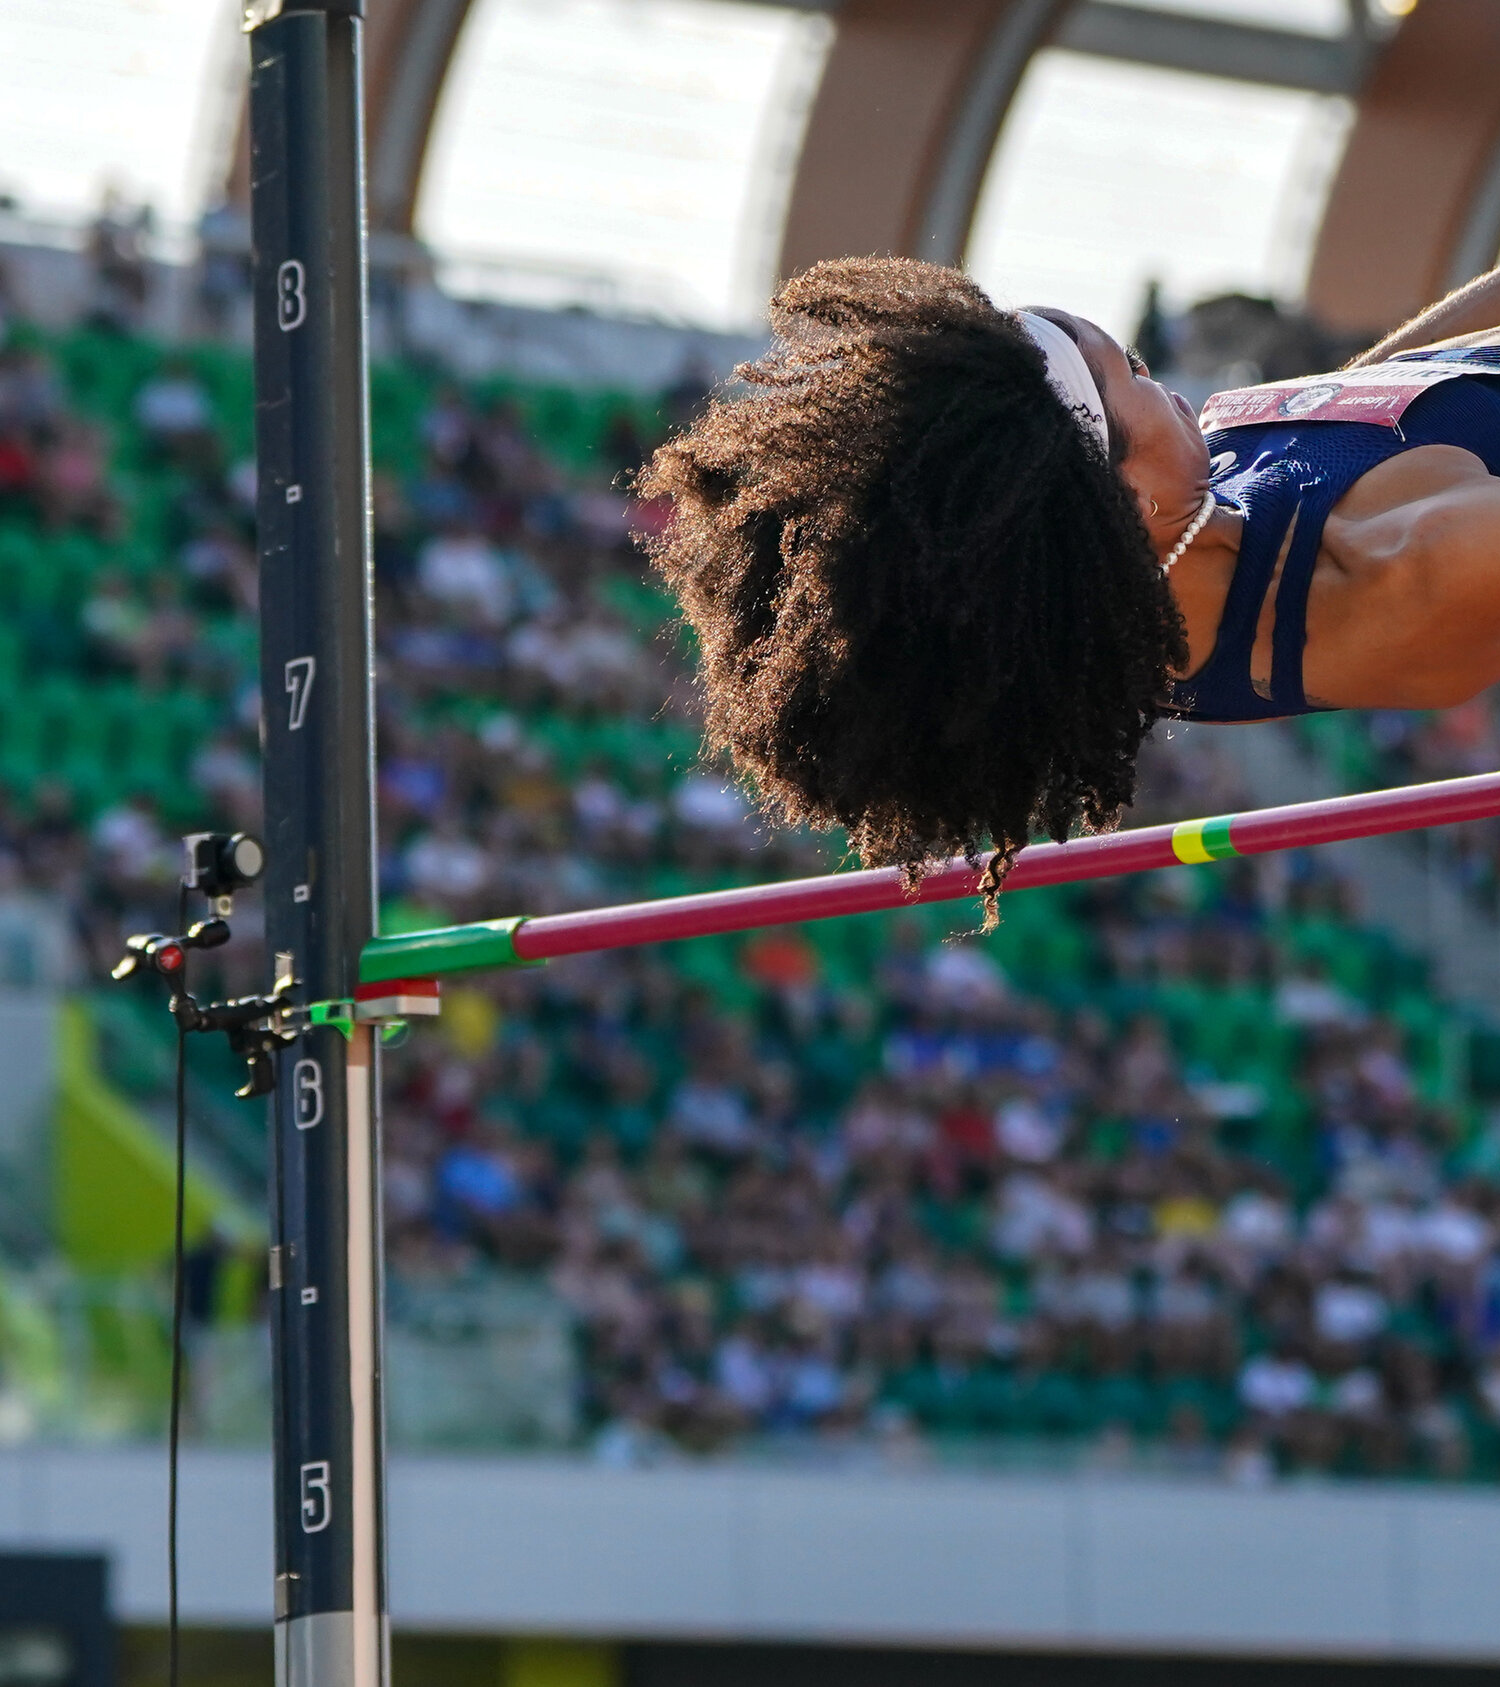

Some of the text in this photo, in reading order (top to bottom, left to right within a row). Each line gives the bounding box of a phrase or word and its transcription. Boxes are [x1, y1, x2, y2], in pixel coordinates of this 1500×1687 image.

[278, 260, 306, 331] 8
[285, 656, 315, 731] 7
[294, 1059, 324, 1131] 6
[301, 1461, 331, 1533] 5
